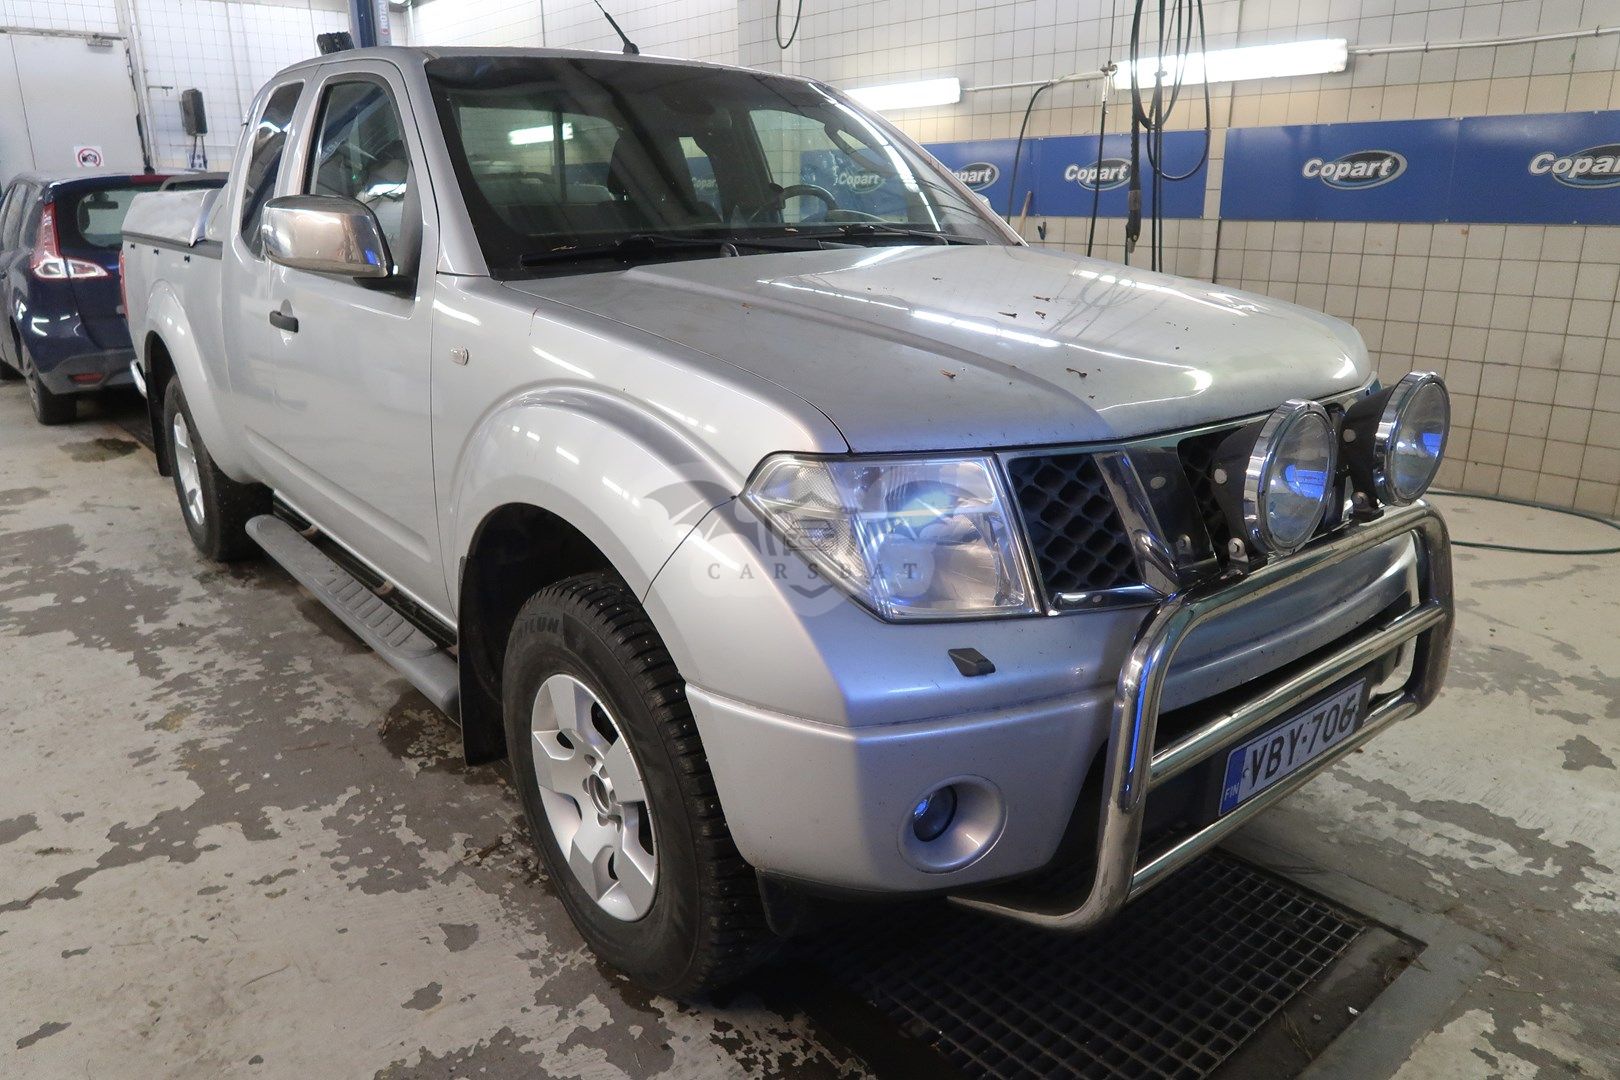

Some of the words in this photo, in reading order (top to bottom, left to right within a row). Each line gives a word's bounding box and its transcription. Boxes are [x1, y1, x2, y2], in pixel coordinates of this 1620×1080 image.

[1065, 164, 1127, 183] Copart
[1303, 158, 1392, 181] Copart
[1529, 152, 1620, 179] Copa
[839, 172, 880, 188] Copart
[1251, 693, 1357, 787] VBY-706
